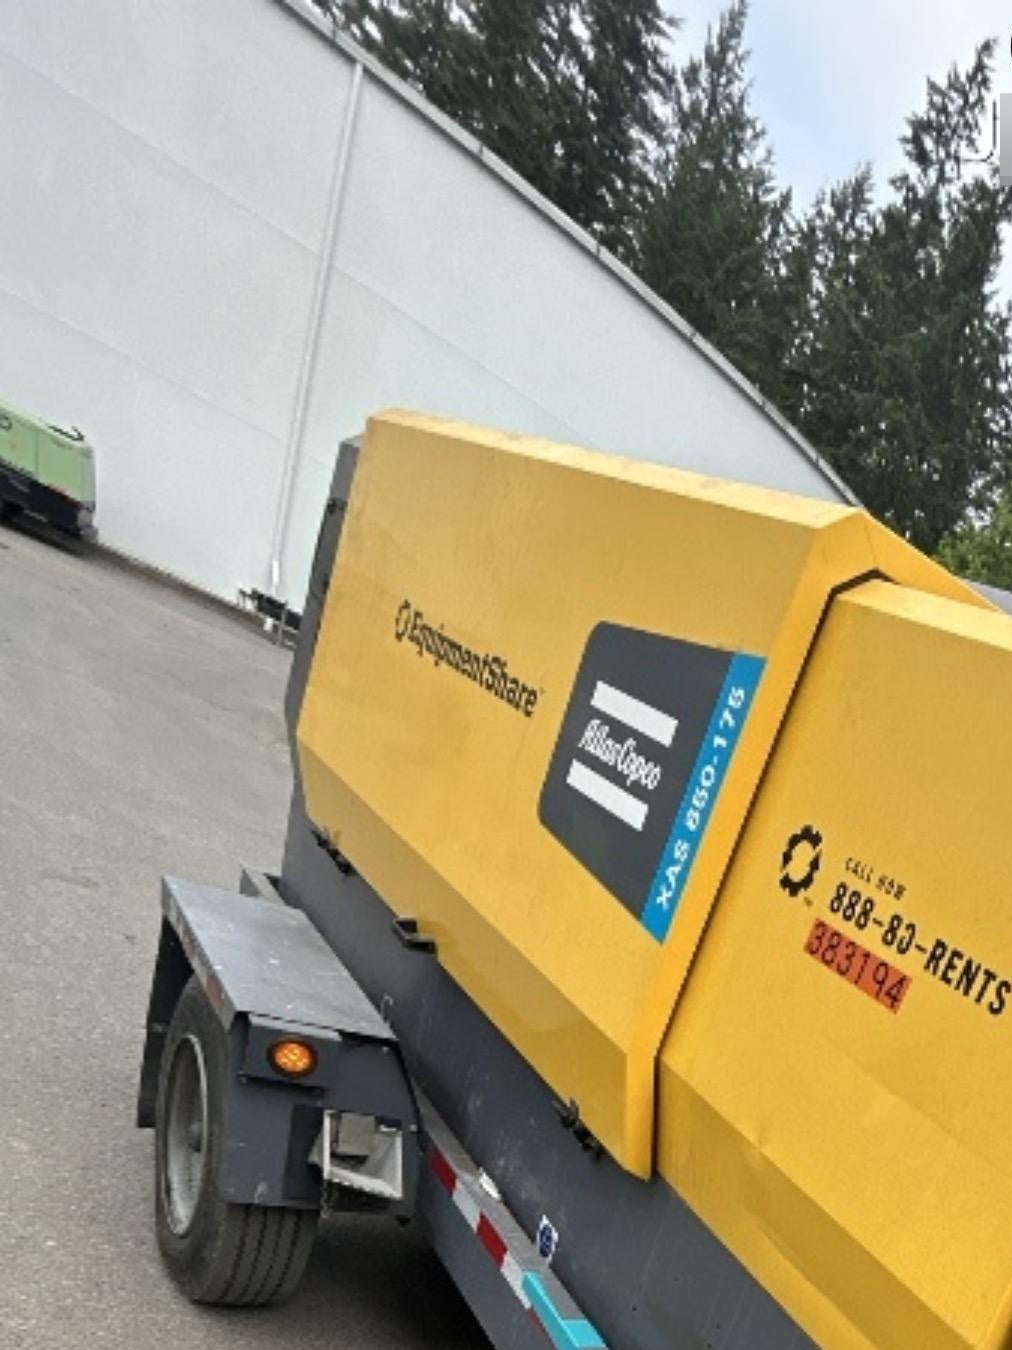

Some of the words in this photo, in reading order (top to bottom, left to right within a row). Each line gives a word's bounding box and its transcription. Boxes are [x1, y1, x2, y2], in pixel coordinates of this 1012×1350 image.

[407, 608, 538, 718] EquipmentShare
[656, 839, 691, 911] XAS
[806, 920, 909, 1010] 383194
